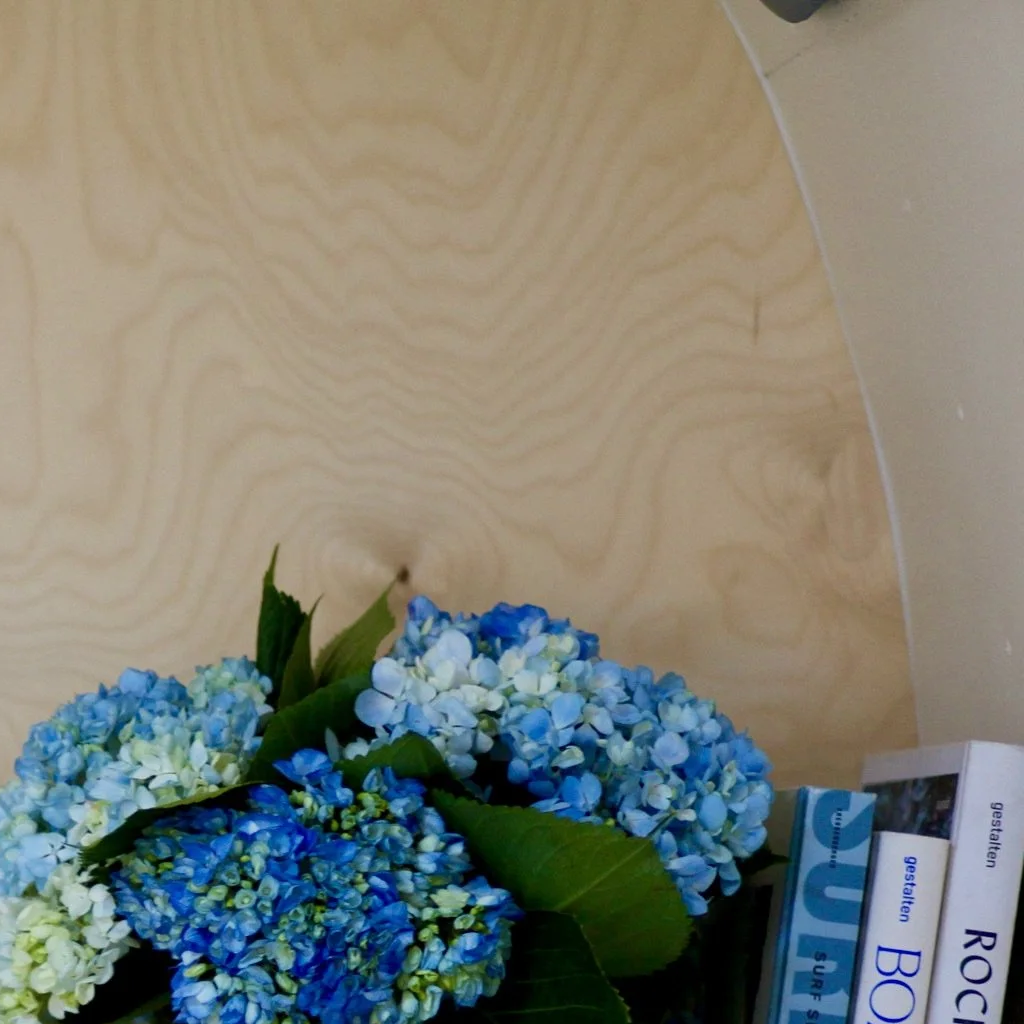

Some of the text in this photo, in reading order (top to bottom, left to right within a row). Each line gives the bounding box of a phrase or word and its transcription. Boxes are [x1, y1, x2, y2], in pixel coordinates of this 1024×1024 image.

[985, 802, 1003, 869] gestalten
[899, 856, 917, 923] gestalten
[810, 951, 827, 1002] SURF
